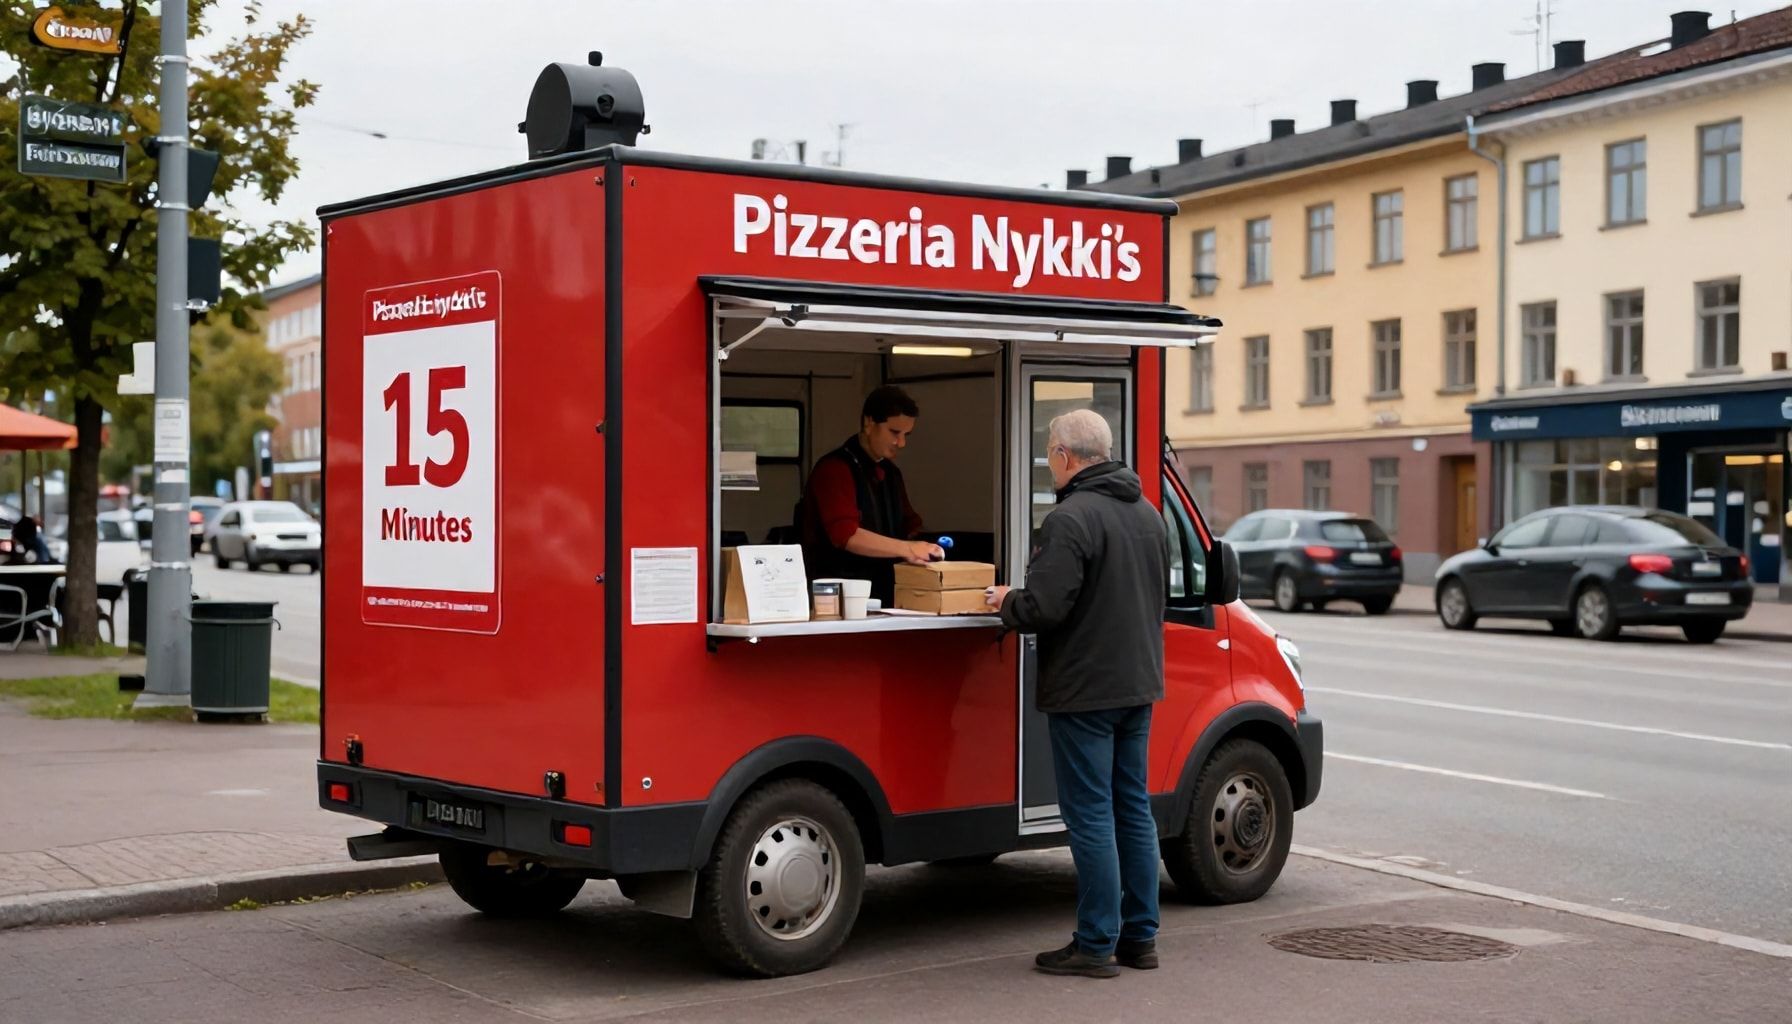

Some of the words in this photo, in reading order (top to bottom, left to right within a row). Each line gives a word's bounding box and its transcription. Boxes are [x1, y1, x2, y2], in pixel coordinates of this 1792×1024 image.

[733, 193, 956, 268] Pizzeria
[971, 213, 1142, 288] Nykki's
[383, 365, 470, 489] 15
[381, 507, 473, 543] Minutes
